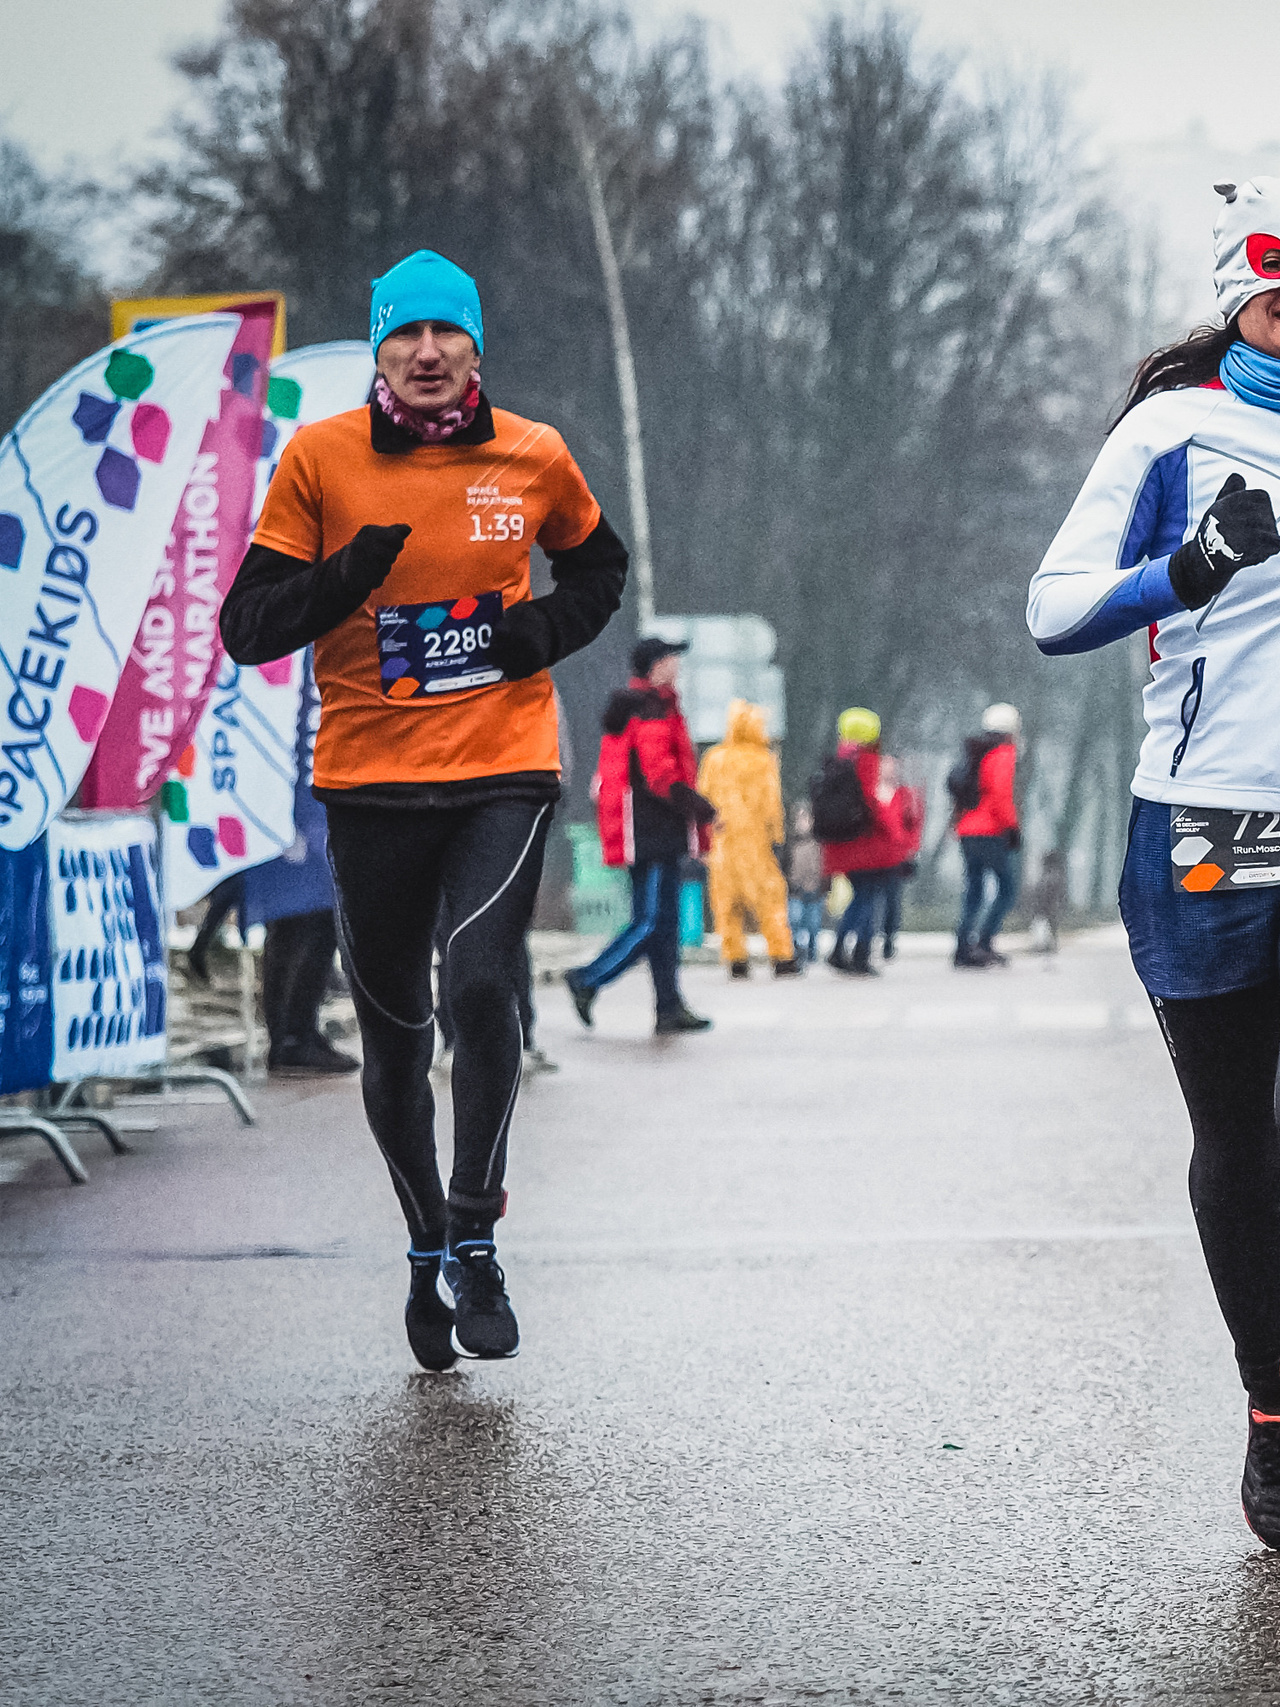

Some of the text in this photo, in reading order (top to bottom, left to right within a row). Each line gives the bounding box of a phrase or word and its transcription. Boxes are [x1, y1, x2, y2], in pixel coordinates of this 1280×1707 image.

[469, 513, 525, 542] 1:39
[181, 451, 223, 698] MARATHON
[141, 604, 175, 701] AND
[424, 623, 492, 658] 2280
